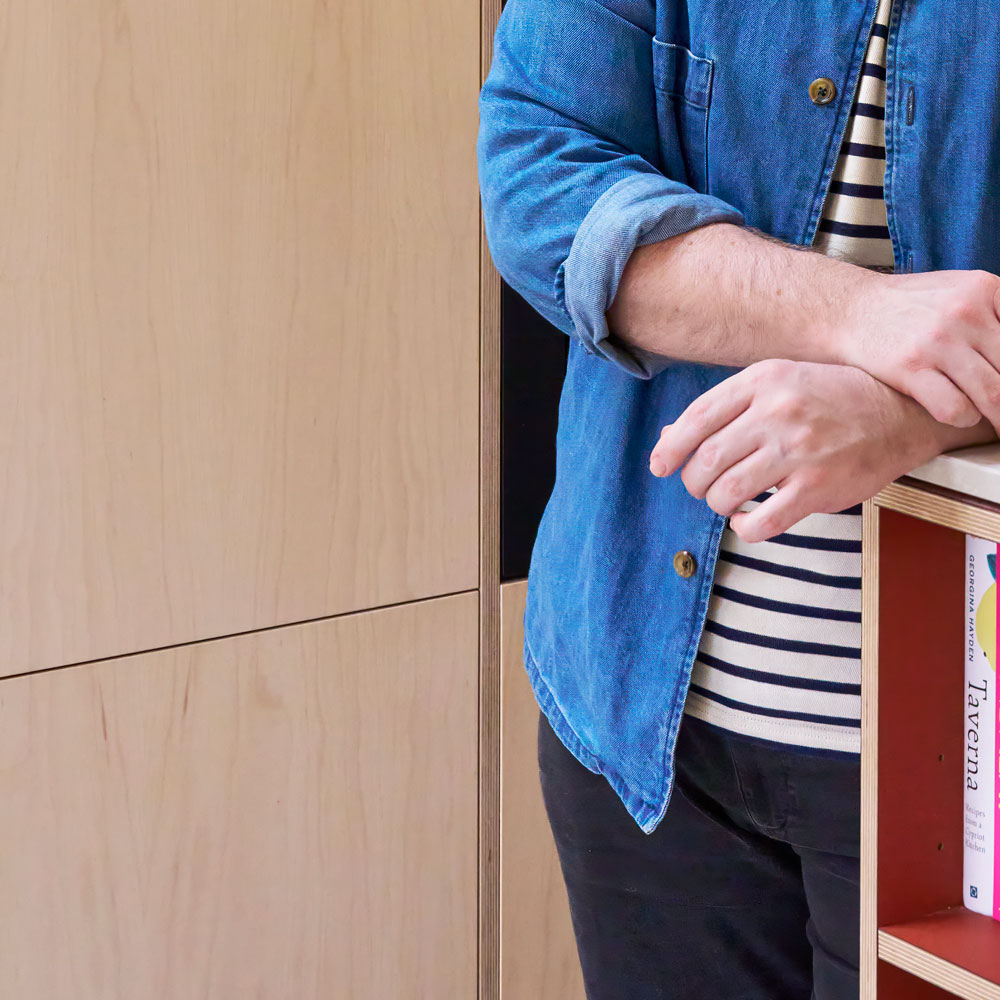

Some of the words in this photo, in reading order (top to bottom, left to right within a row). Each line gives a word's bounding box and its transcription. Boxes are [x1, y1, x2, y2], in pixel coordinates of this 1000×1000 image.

[967, 617, 975, 663] HAYDEN
[966, 679, 988, 791] Taverna
[965, 828, 985, 842] Cypriot
[965, 839, 986, 854] Kitchen
